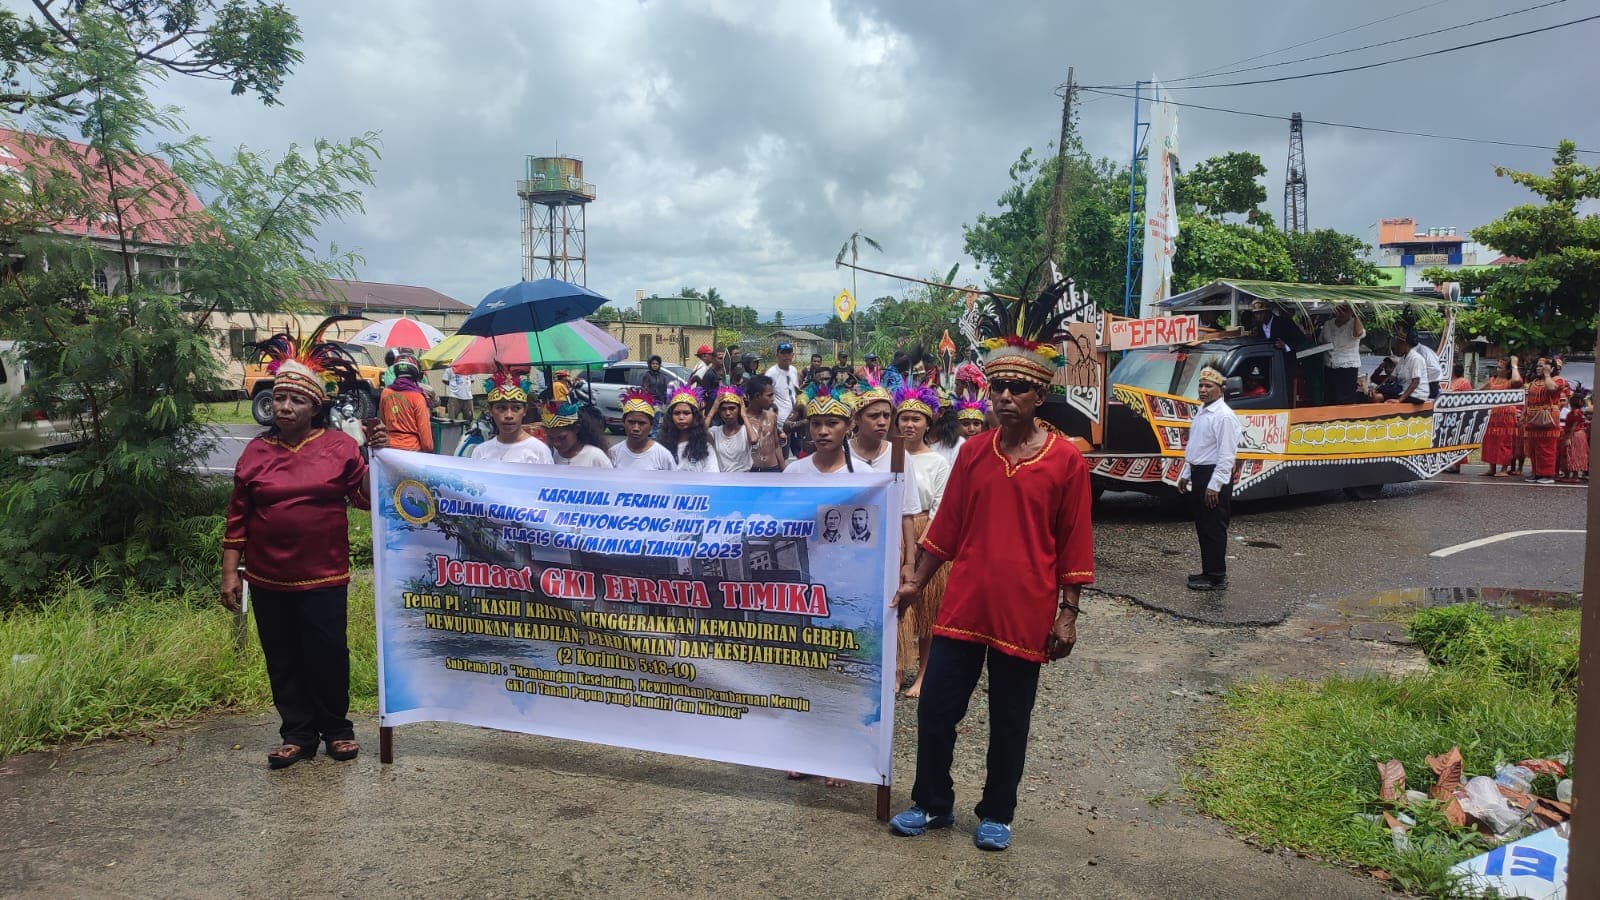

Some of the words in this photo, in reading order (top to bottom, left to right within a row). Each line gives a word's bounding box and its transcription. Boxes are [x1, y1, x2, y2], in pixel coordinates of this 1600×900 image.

[1111, 322, 1127, 335] GKI
[1128, 317, 1197, 347] EFRATA
[537, 487, 611, 506] KARNAVAL
[614, 491, 671, 509] PERAHU
[673, 495, 710, 511] INJIL
[439, 499, 484, 517] DALAM
[488, 503, 547, 523] RANGKA
[553, 511, 671, 533] MENYONGSONG
[674, 518, 704, 534] HUT
[706, 519, 721, 534] PI
[724, 520, 742, 535] KE
[747, 520, 777, 536] 168
[782, 521, 814, 537] THN
[504, 527, 550, 546] KLASIS
[553, 532, 582, 549] GKI
[581, 536, 643, 556] MIMIKA
[646, 539, 695, 557] TAHUN
[696, 542, 742, 559] 2023
[434, 554, 535, 593] Jemaat
[539, 567, 596, 600] GKI
[603, 574, 712, 609] EFRATA
[718, 580, 830, 618] TIMIKA
[403, 591, 441, 610] Tema
[445, 595, 459, 612] PI
[473, 597, 521, 618] "KASIH
[525, 602, 578, 624] KRISTUS
[580, 611, 695, 635] MENGGERAKKAN
[699, 619, 797, 643] KEMANDIRIAN
[801, 627, 860, 650] GEREJA.
[425, 613, 510, 637] MEWUJUDKAN
[513, 622, 584, 645] KEADILAN,
[588, 630, 676, 657] PERDAMAIAN
[679, 640, 711, 660] DAN
[556, 647, 573, 666] (2
[576, 648, 637, 671] Korintus
[638, 657, 697, 681] 5:18-19)
[446, 657, 489, 674] SubTema
[489, 663, 502, 676] PI
[509, 665, 576, 684] "Membangun
[638, 679, 705, 700] Mewujudkan
[705, 687, 769, 708] Pembaruan
[769, 694, 810, 713] Menuju
[505, 679, 525, 693] GKI
[525, 681, 537, 695] di
[538, 682, 570, 699] Tanah
[571, 687, 605, 705] Papua
[605, 693, 631, 709] yang
[632, 694, 673, 712] Mandiri
[674, 699, 696, 714] dan
